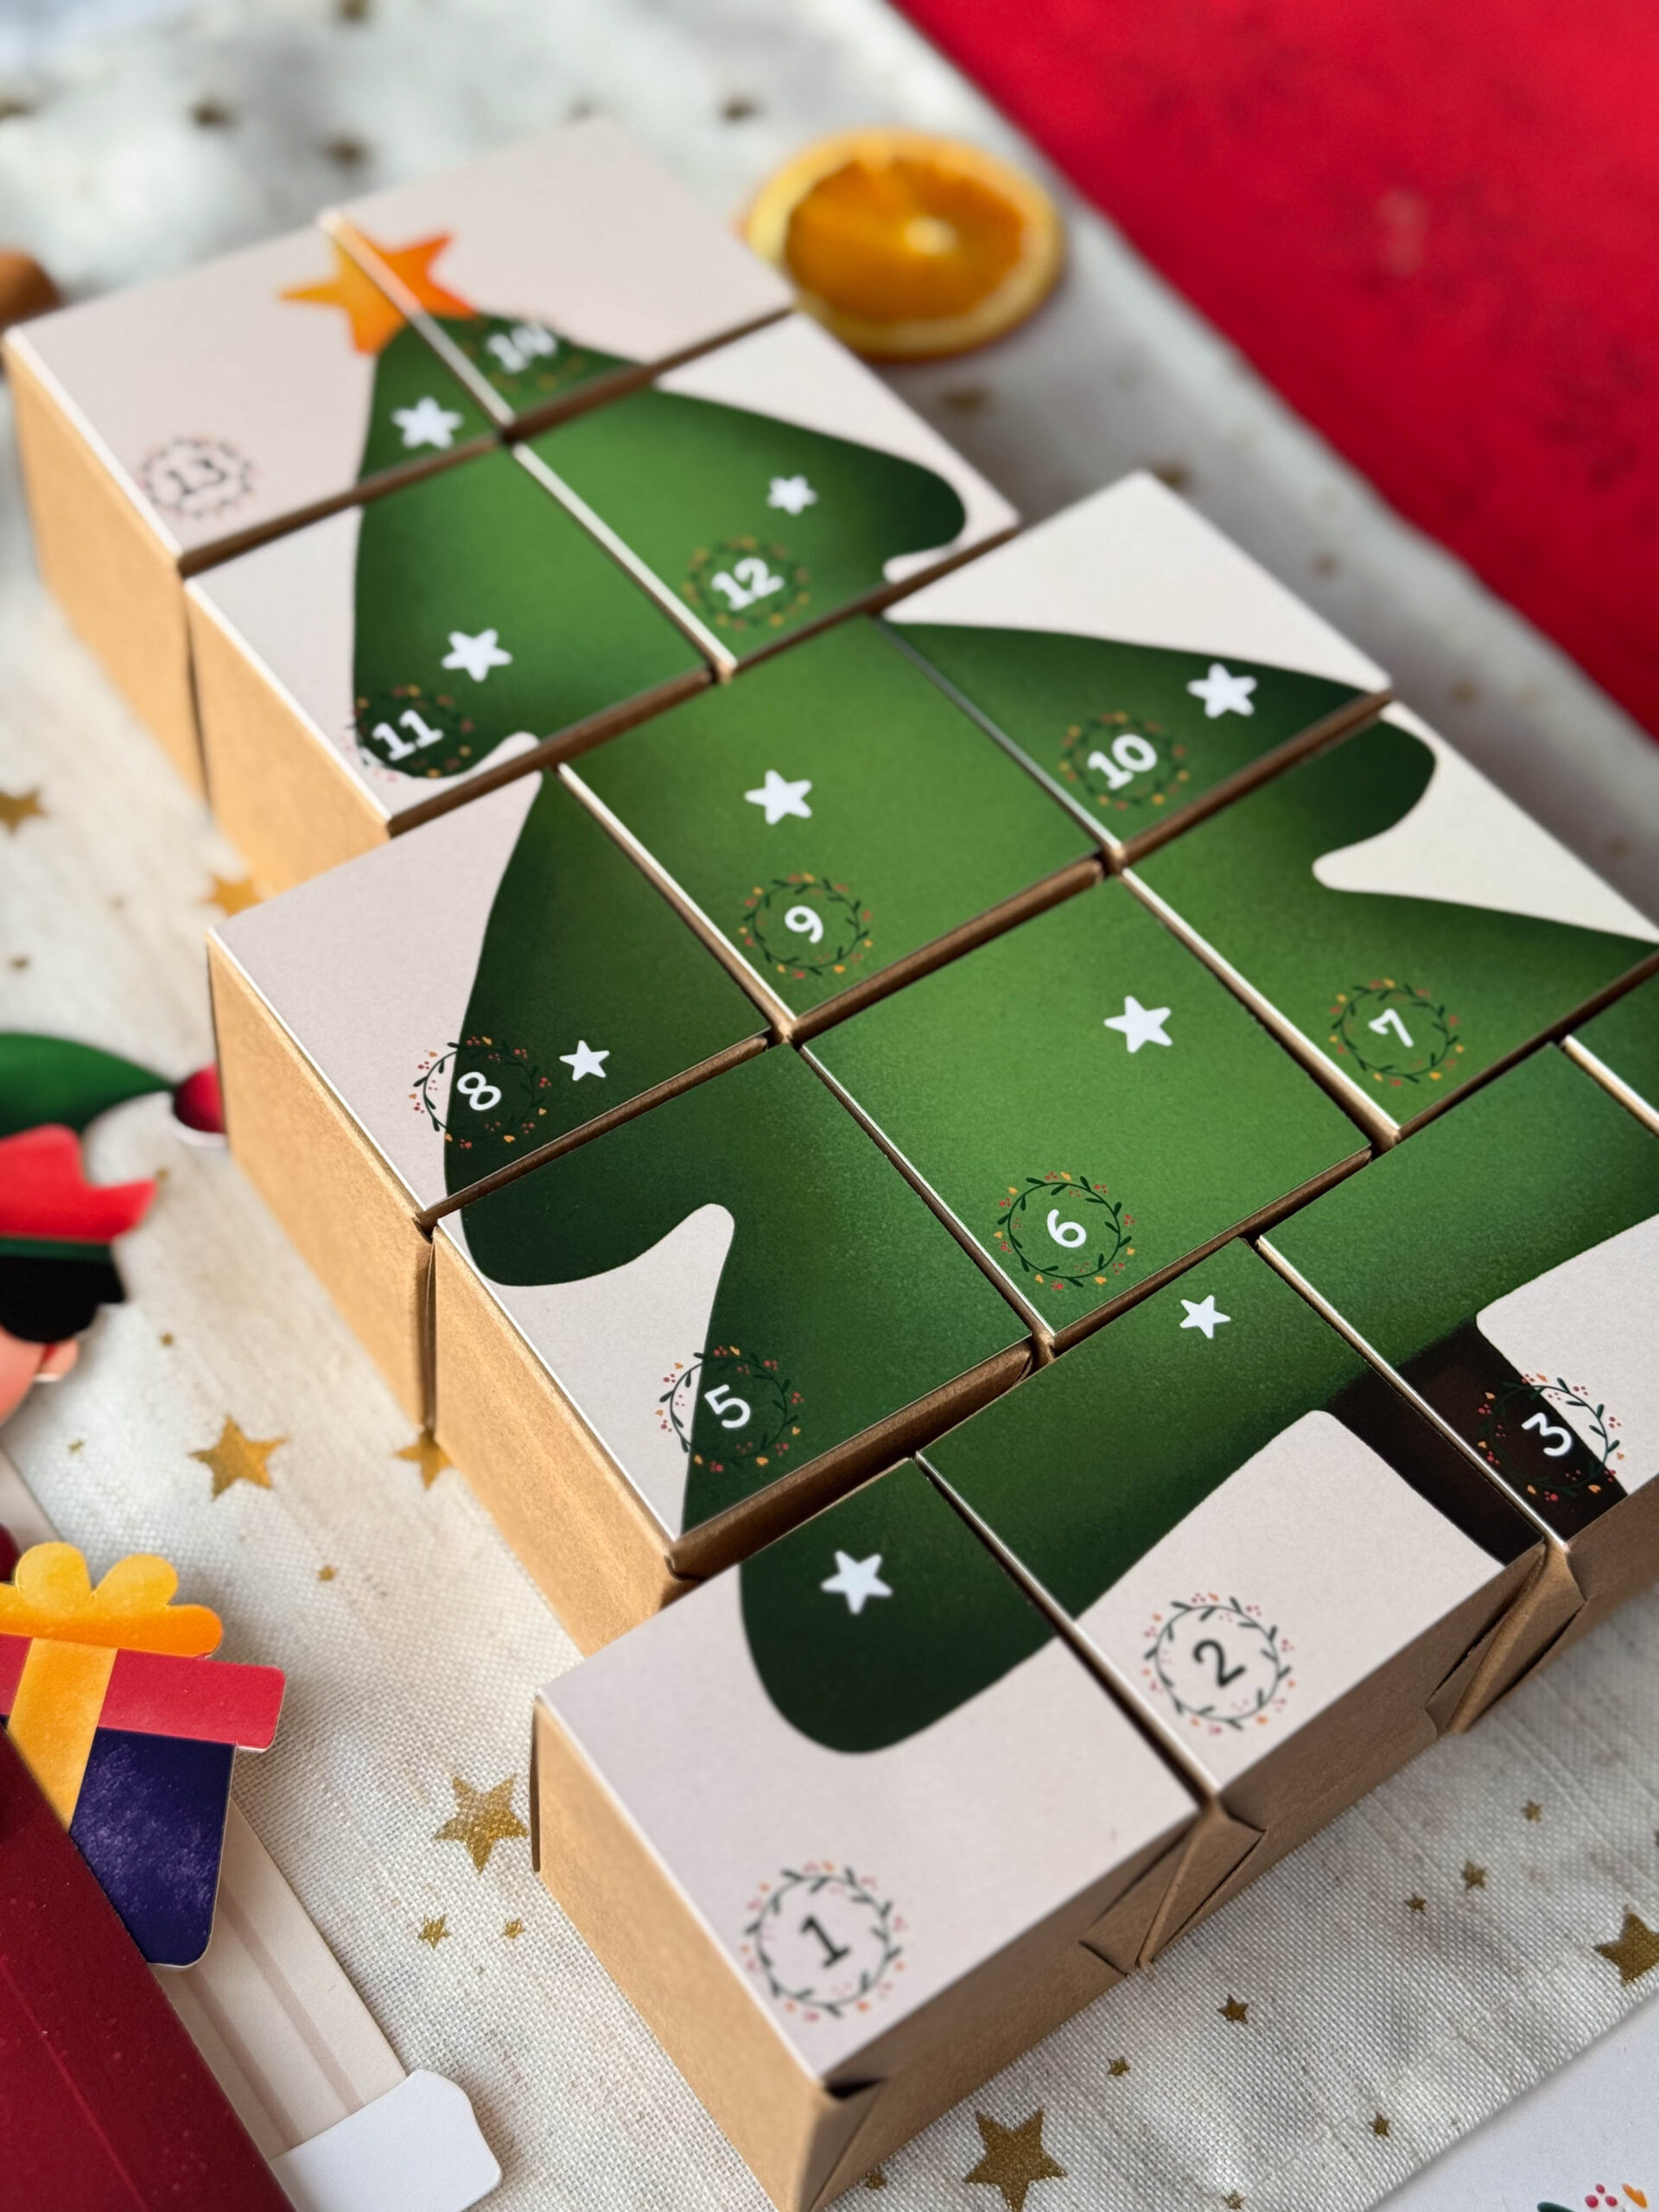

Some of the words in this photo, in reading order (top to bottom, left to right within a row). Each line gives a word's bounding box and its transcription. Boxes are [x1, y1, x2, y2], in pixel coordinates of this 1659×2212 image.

[711, 557, 785, 611] 12
[372, 709, 443, 760] 11
[1087, 734, 1158, 790] 10
[784, 905, 824, 944] 9
[1368, 1007, 1414, 1048] 7
[456, 1071, 502, 1111] 8
[1046, 1208, 1088, 1249] 6
[703, 1384, 751, 1429] 5
[1521, 1412, 1573, 1457] 3
[1192, 1638, 1246, 1688] 2
[800, 1915, 850, 1967] 1
